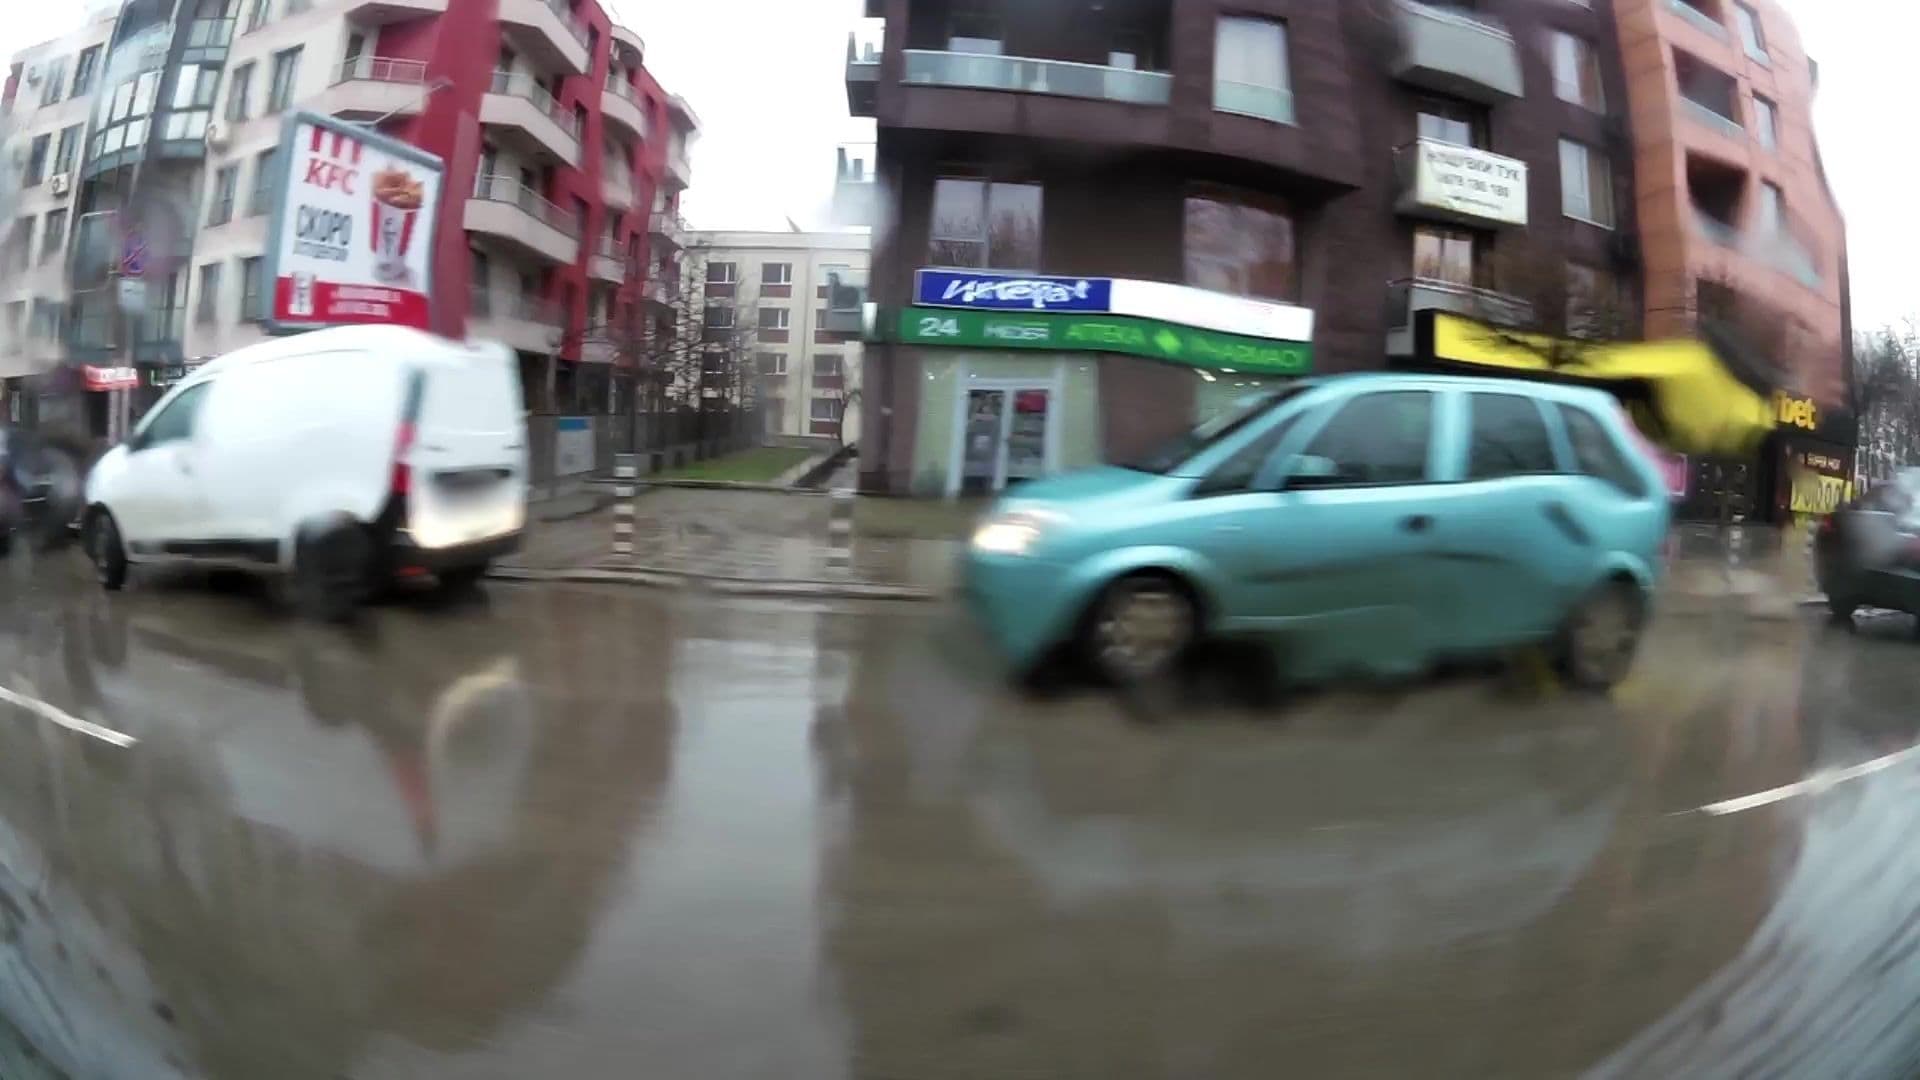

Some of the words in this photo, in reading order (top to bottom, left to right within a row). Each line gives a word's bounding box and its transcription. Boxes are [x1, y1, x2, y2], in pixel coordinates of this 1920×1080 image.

[303, 158, 360, 195] KFC
[295, 203, 353, 247] СКОРО
[919, 316, 961, 338] 24
